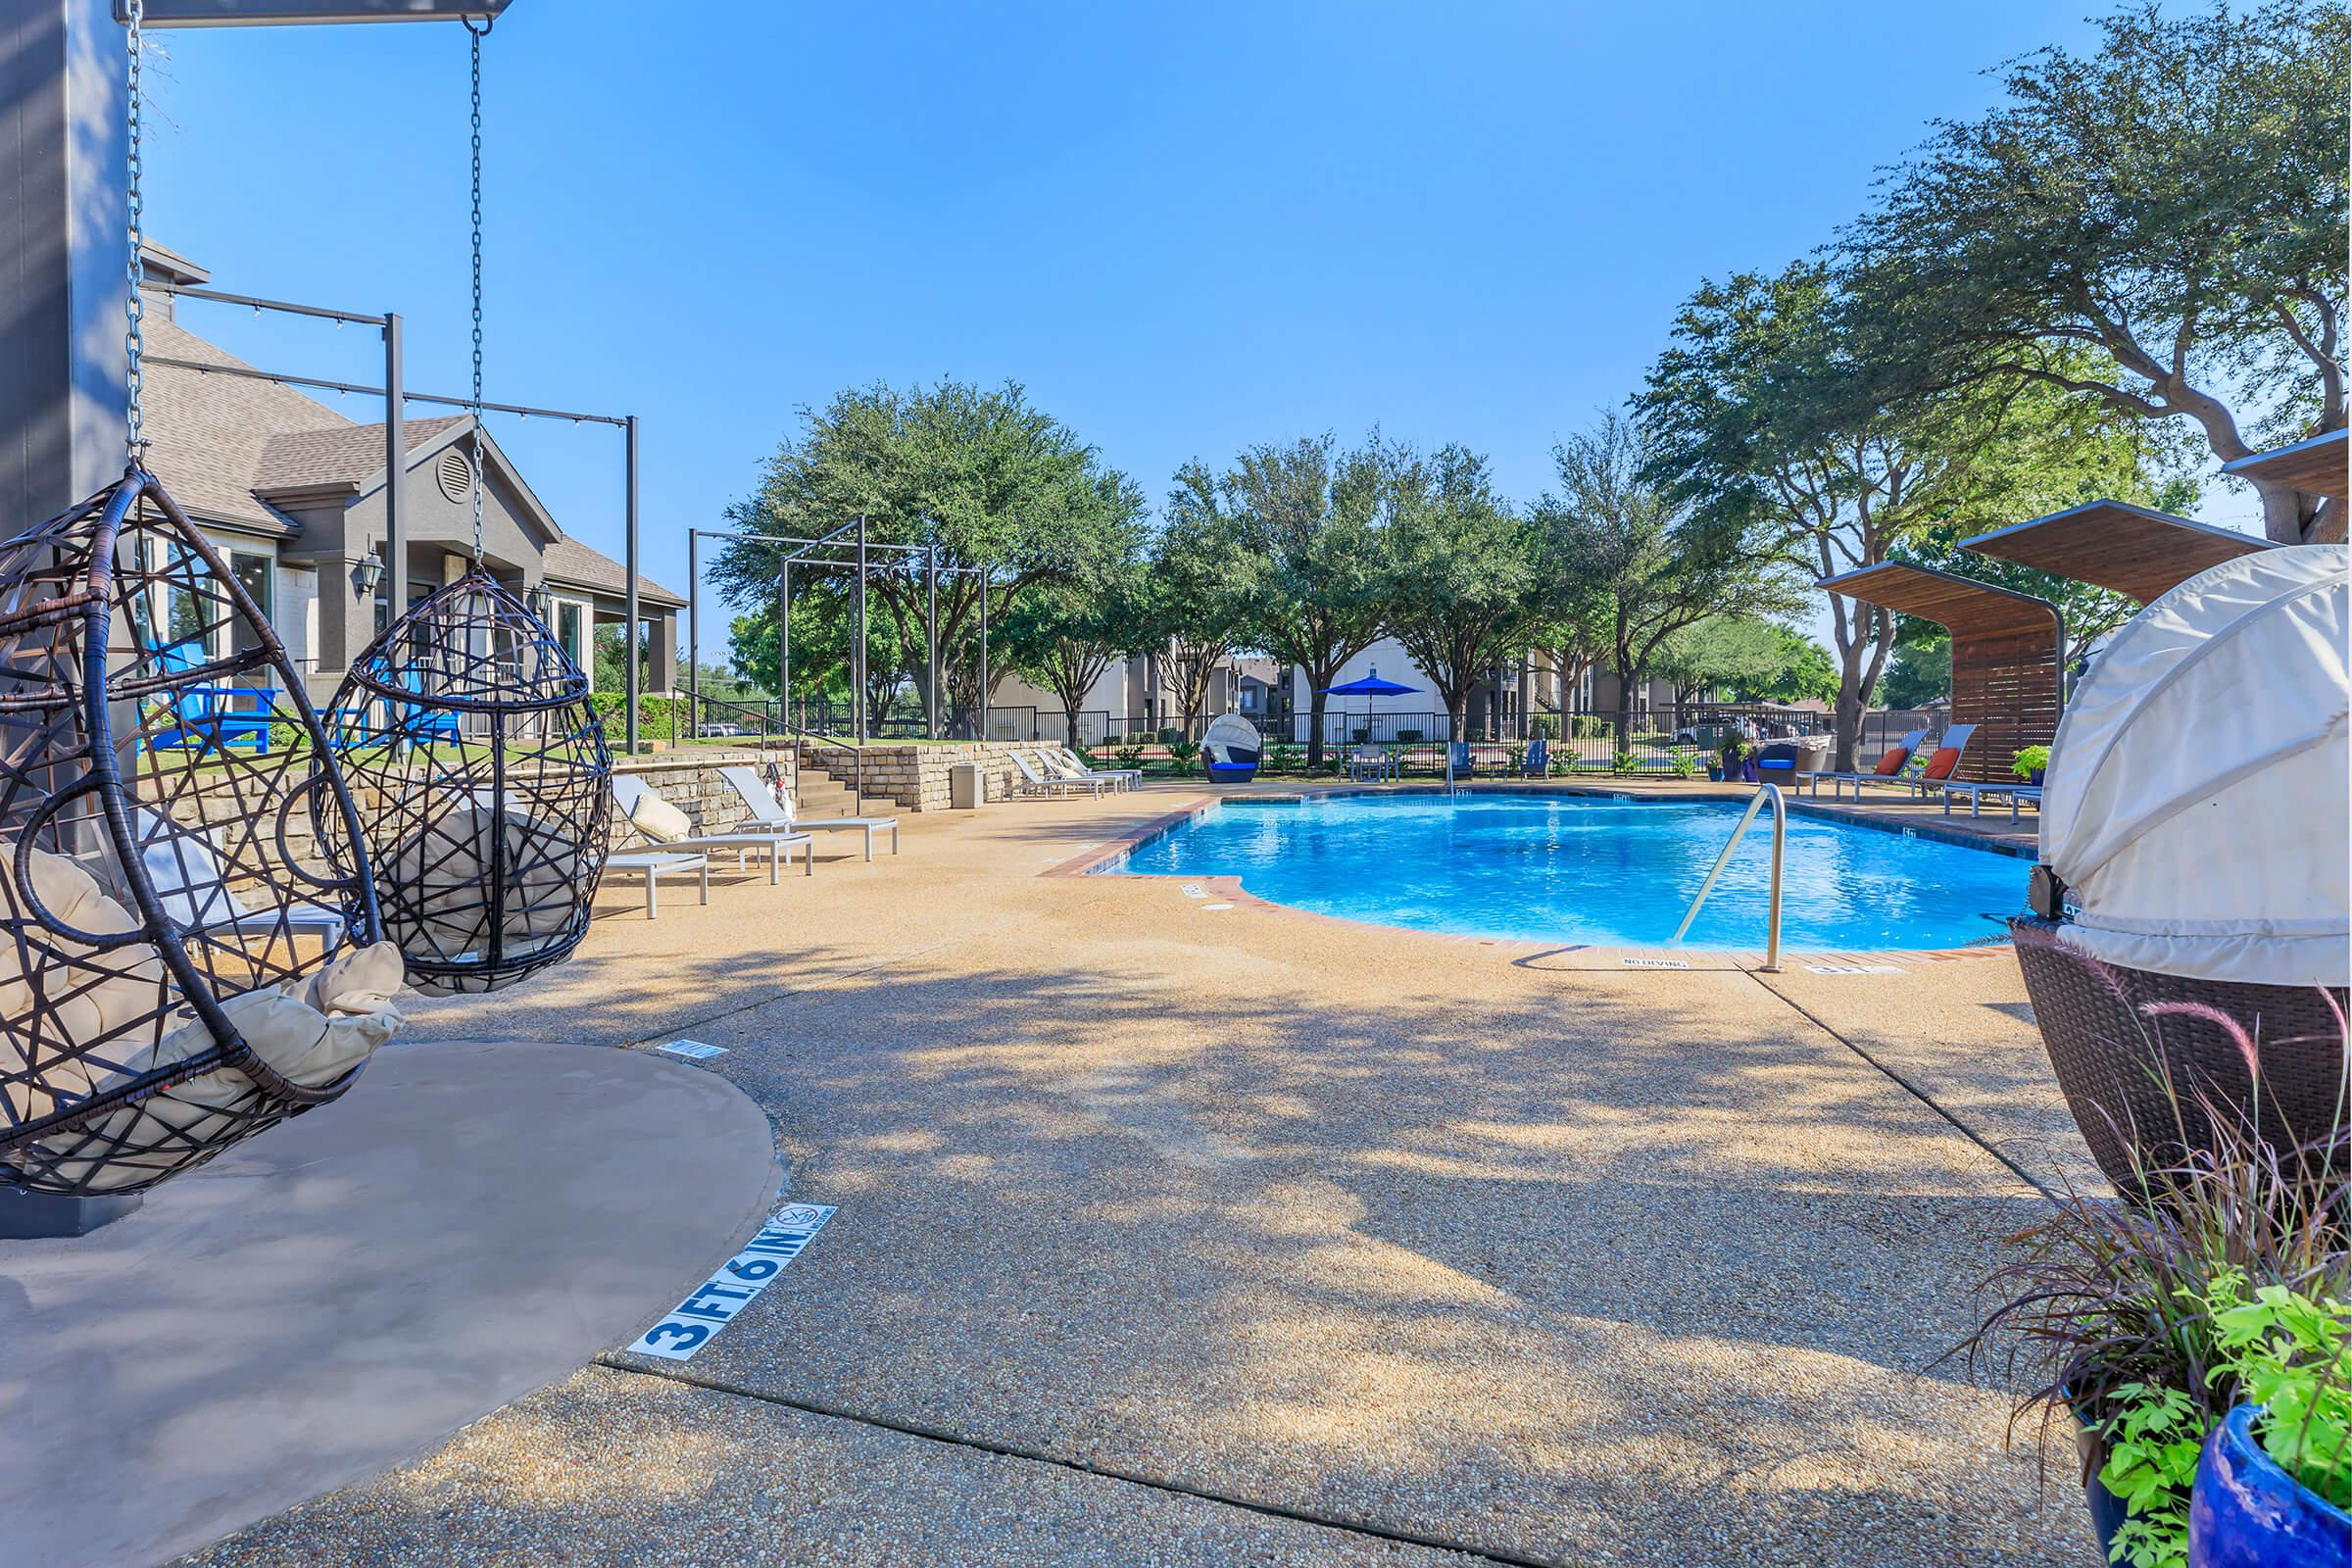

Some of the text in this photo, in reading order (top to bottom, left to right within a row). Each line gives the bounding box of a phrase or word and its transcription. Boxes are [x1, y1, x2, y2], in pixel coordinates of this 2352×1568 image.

[1642, 959, 1687, 968] DIVING
[725, 1258, 779, 1281] 6
[675, 1282, 756, 1319] FT.
[645, 1322, 710, 1351] 3
